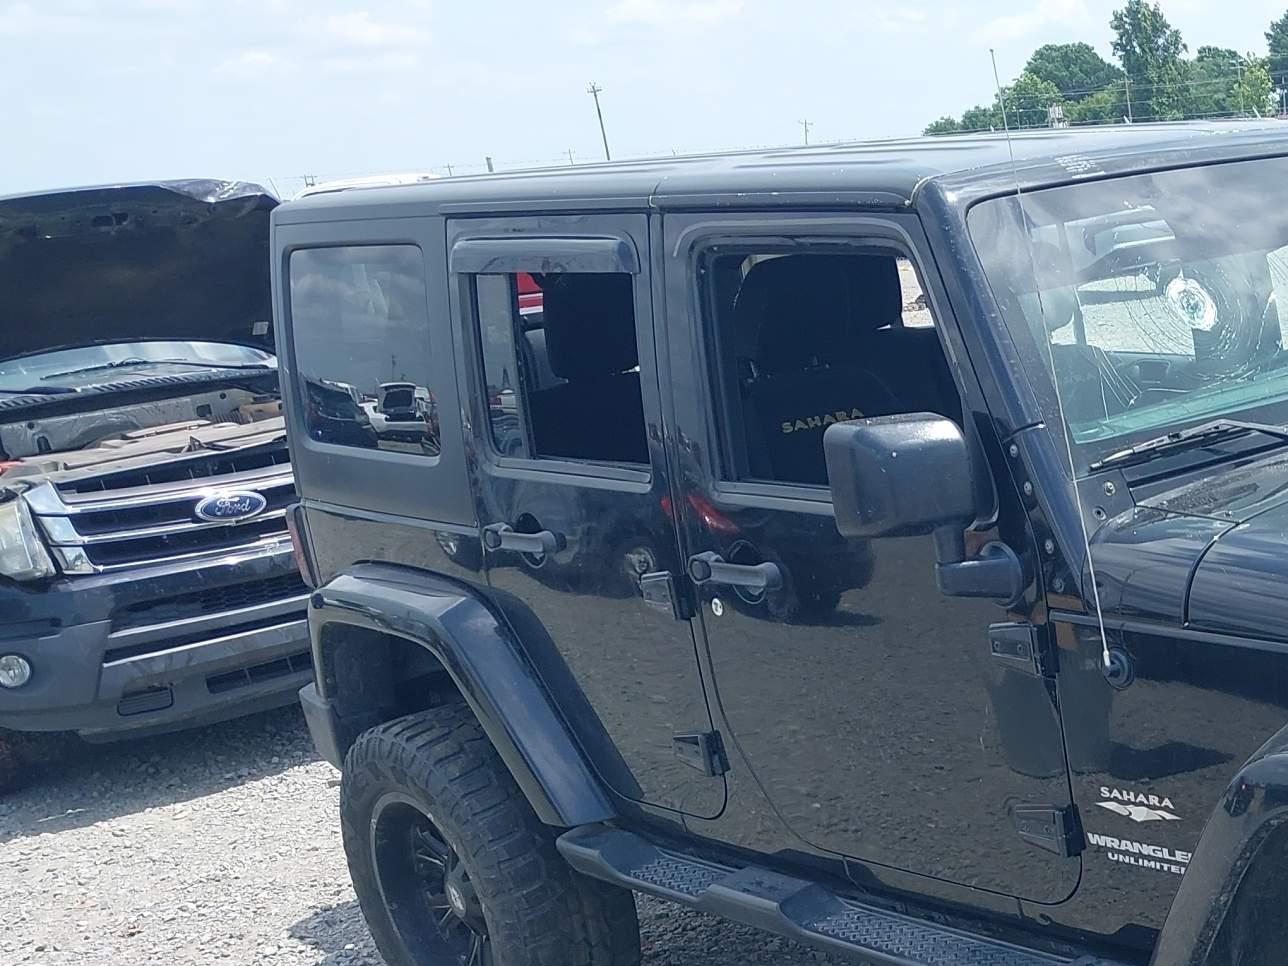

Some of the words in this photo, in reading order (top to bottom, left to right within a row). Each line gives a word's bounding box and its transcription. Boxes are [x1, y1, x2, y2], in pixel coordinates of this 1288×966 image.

[782, 408, 864, 433] SAHARA
[215, 496, 252, 516] Ford
[1100, 786, 1175, 810] SAHARA
